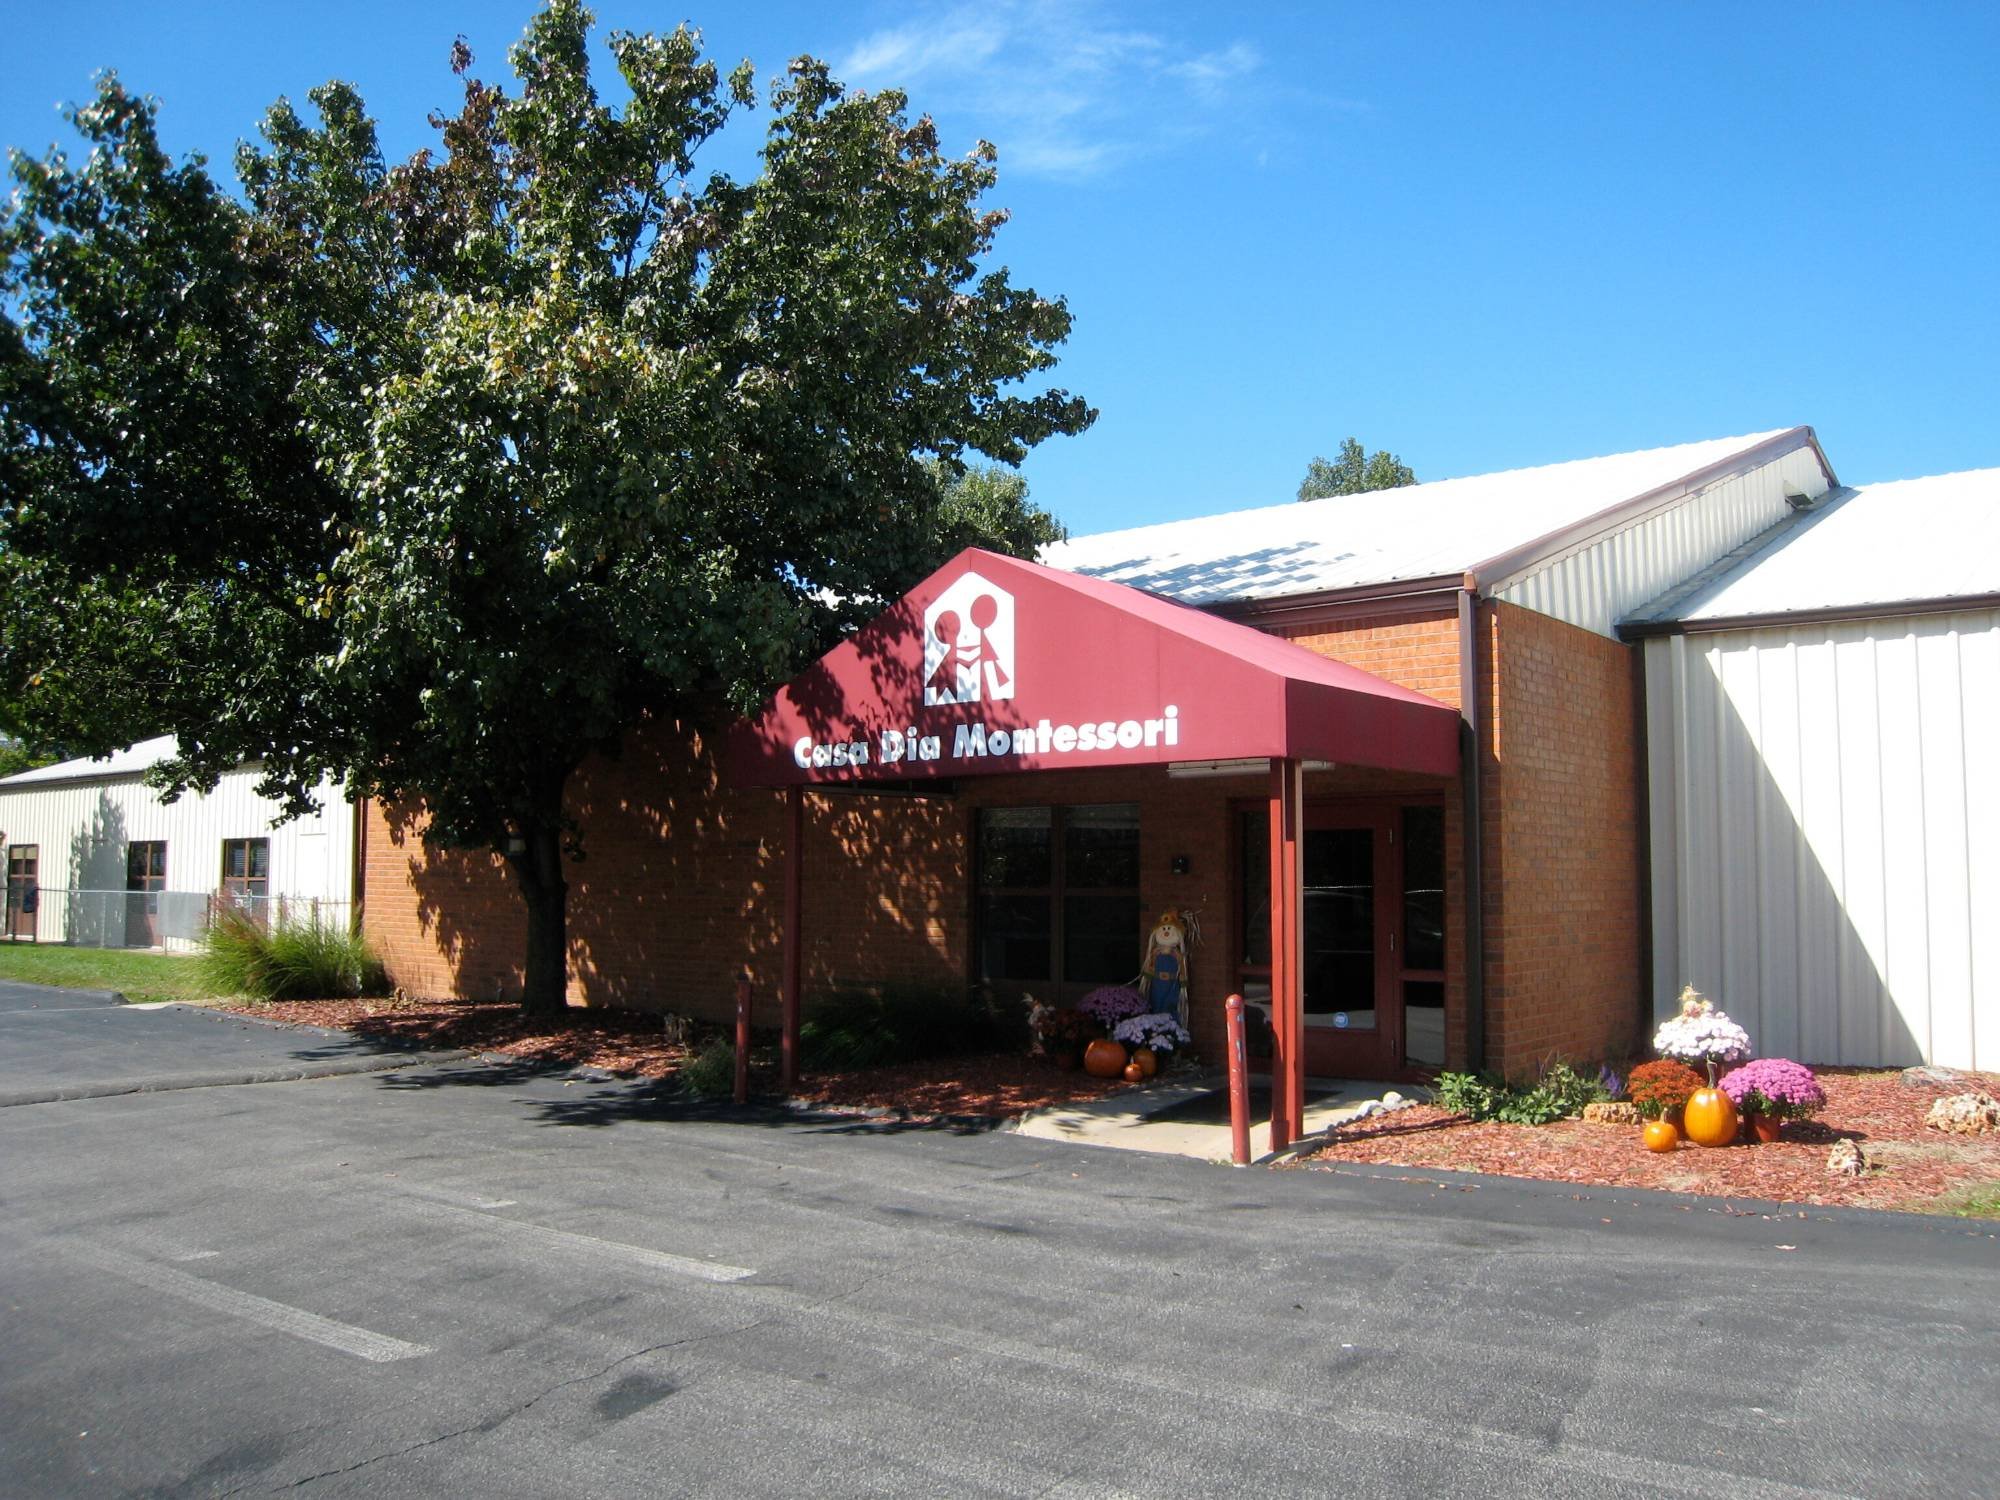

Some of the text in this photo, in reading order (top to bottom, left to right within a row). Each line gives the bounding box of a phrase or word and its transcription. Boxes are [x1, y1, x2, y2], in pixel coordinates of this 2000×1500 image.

[794, 705, 1179, 769] Casa Dia Montessori
